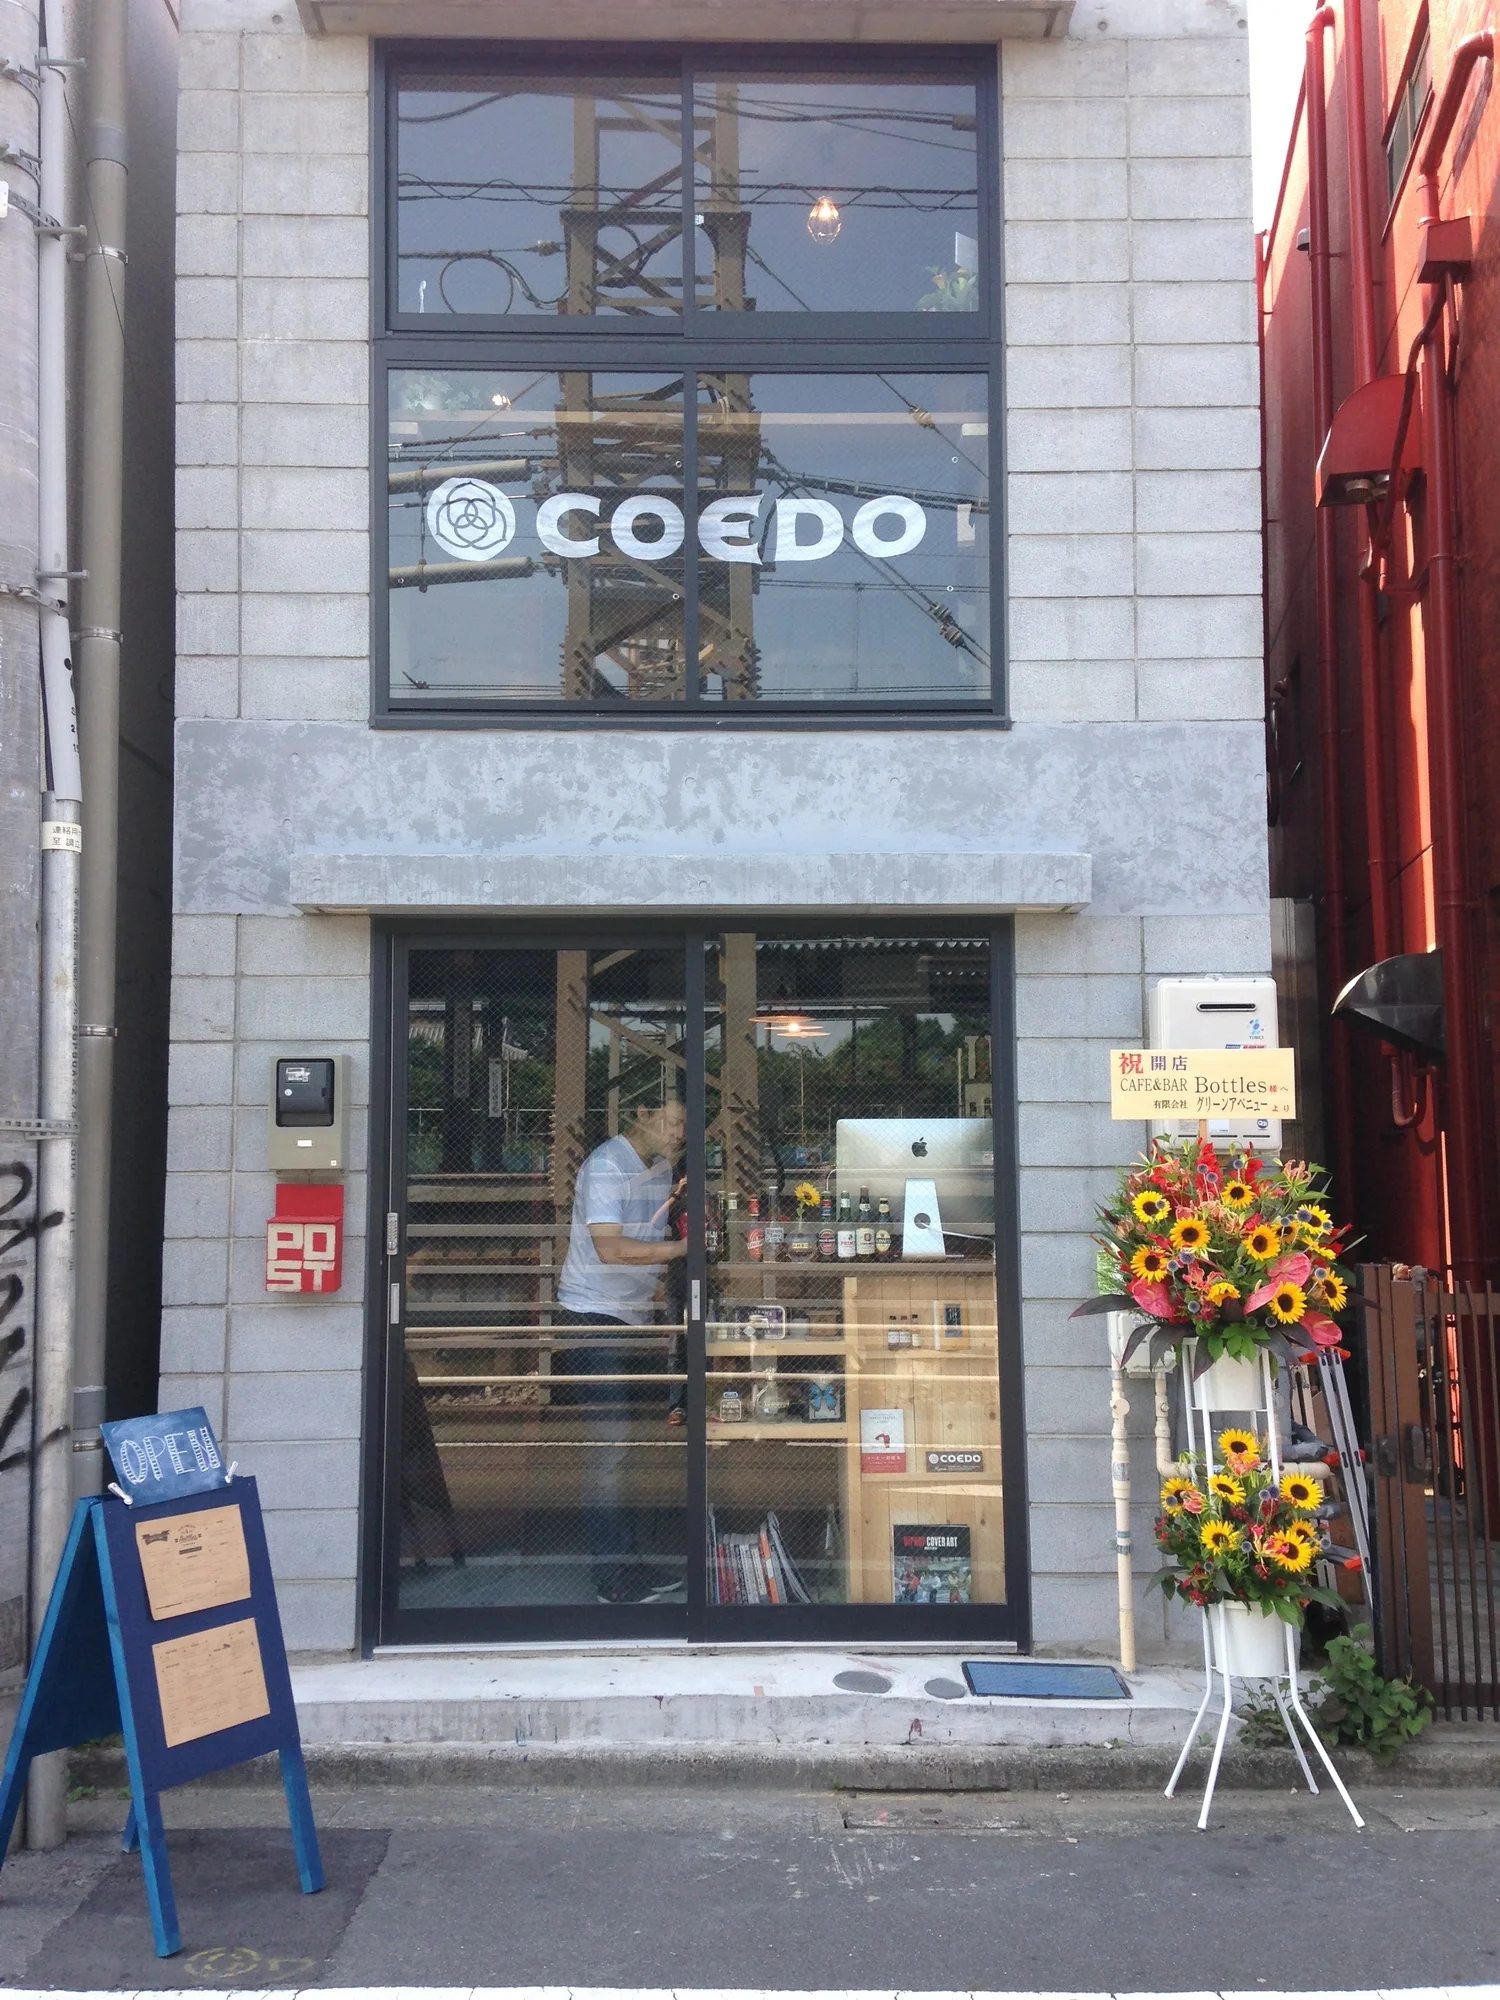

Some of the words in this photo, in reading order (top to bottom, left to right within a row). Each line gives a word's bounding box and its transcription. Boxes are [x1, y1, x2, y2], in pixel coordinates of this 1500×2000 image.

[536, 492, 927, 566] COEDO
[1118, 1053, 1144, 1075] 祝
[1151, 1055, 1188, 1072] 開店
[1120, 1077, 1188, 1092] CAFE&BAR
[1195, 1076, 1268, 1094] Bottles
[1153, 1099, 1188, 1110] 有限会社
[1196, 1097, 1269, 1113] グリーンアベニュー
[1271, 1105, 1290, 1113] より
[119, 1426, 221, 1485] OPEN
[940, 1454, 981, 1463] COEDO
[926, 1536, 946, 1547] COVER
[946, 1536, 958, 1547] ART
